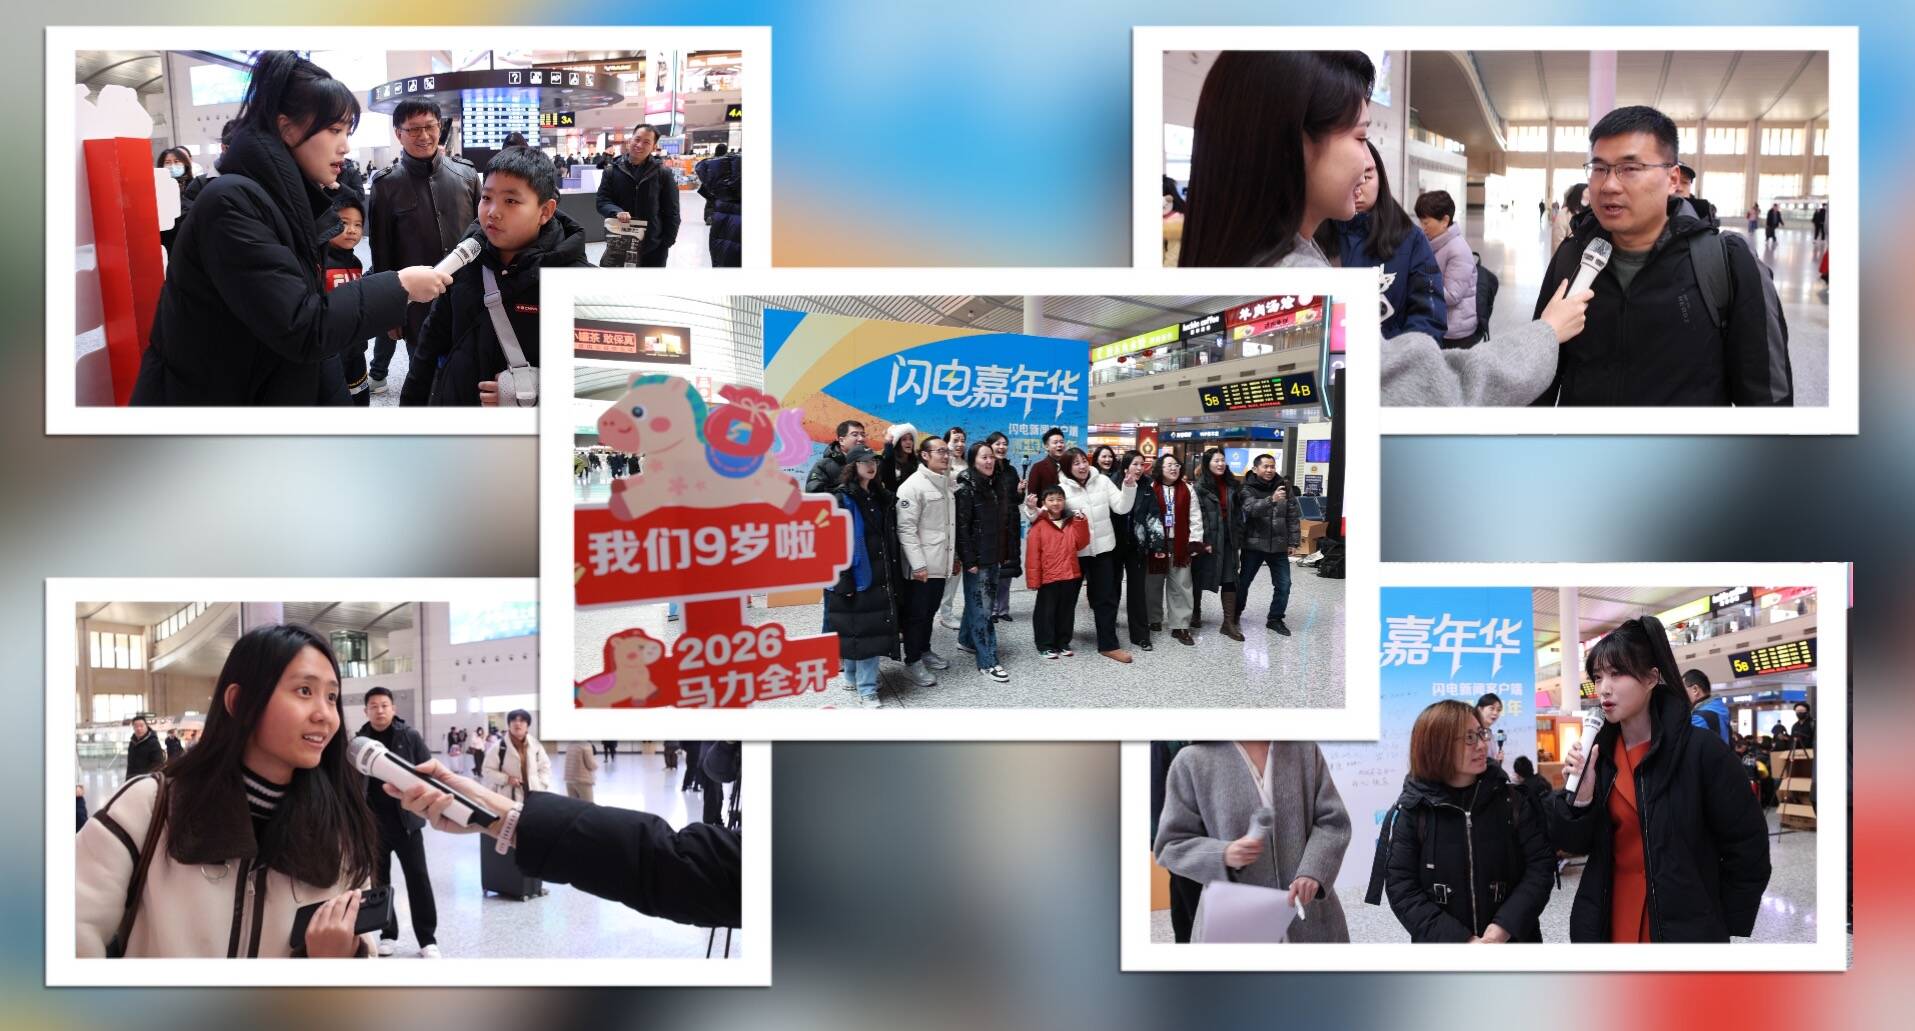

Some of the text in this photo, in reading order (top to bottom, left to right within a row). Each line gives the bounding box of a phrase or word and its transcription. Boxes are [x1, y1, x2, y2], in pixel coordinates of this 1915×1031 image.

[888, 355, 1081, 421] 闪电嘉年华
[1204, 393, 1220, 407] 5B
[1290, 382, 1311, 397] 4B
[1009, 423, 1079, 437] 闪电新闻户端
[588, 521, 816, 576] 我们9岁啦
[678, 627, 783, 672] 2026
[1381, 613, 1523, 679] 嘉年华
[1733, 659, 1749, 673] 5B
[676, 658, 829, 707] 马力全开
[1432, 682, 1523, 697] 闪电新闻客户端
